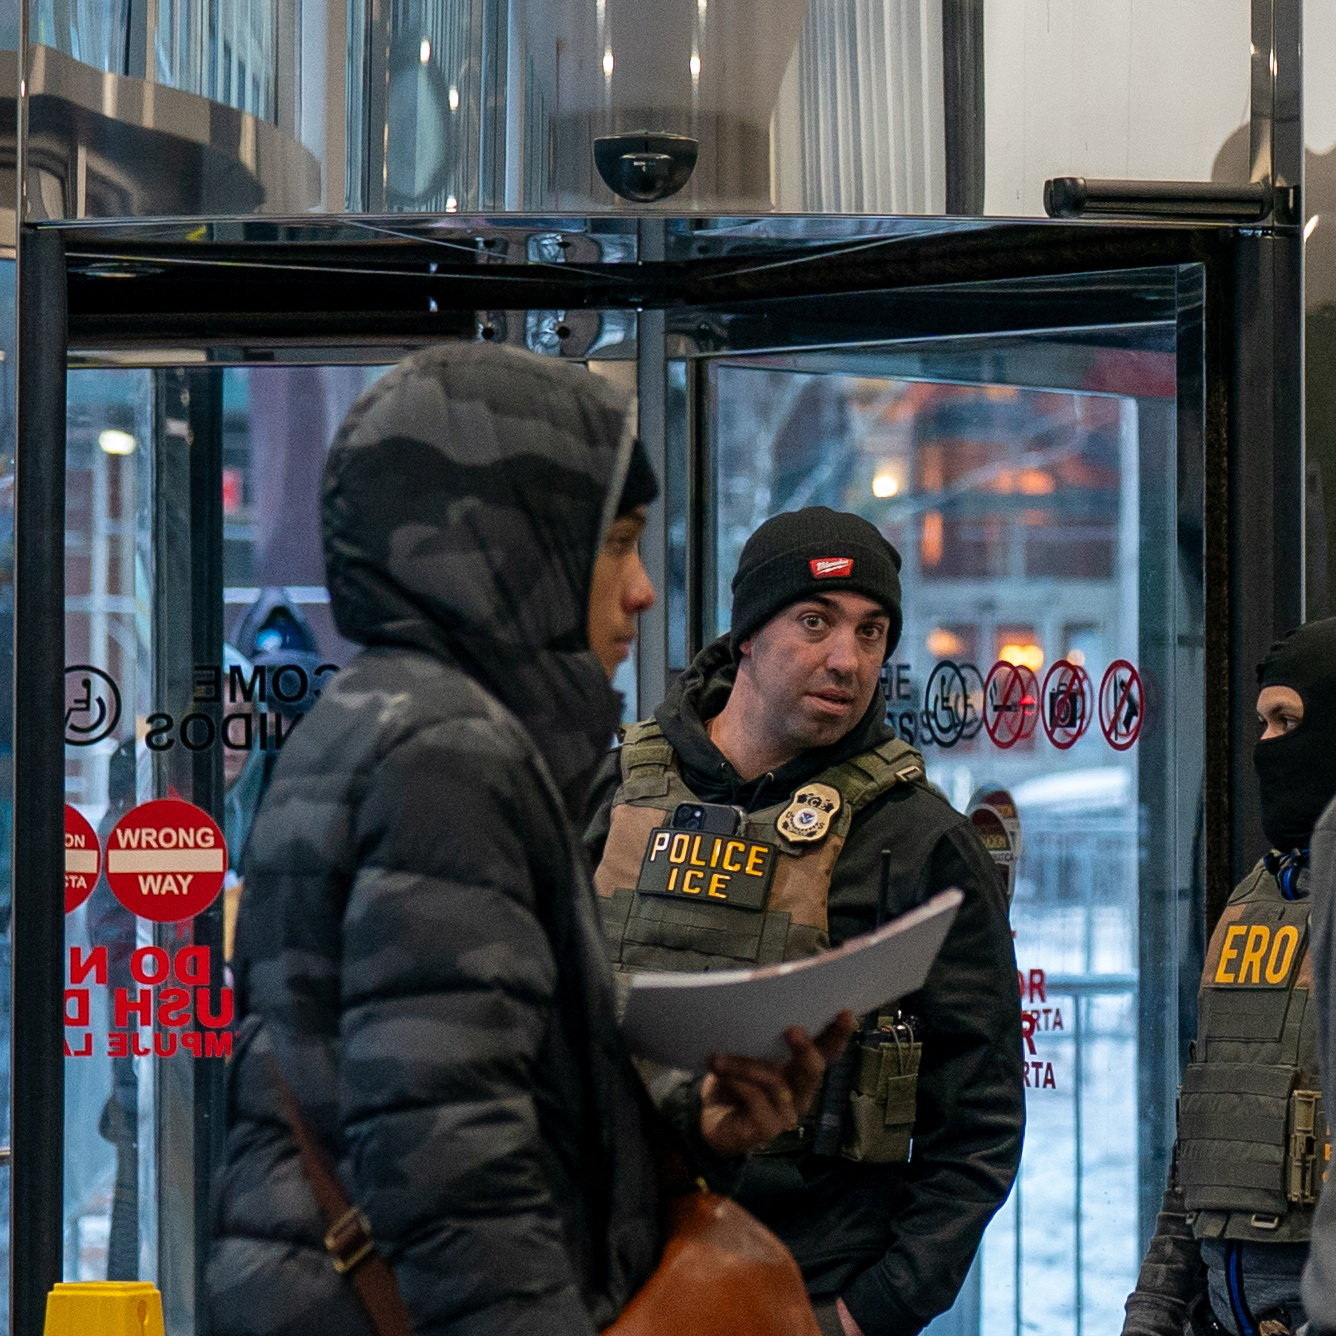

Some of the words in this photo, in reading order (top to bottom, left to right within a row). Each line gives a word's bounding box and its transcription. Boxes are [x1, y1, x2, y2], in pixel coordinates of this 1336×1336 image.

[116, 827, 215, 849] WRONG
[650, 832, 769, 877] POLICE
[138, 874, 193, 895] WAY
[667, 867, 732, 899] ICE
[1215, 925, 1299, 985] ERO
